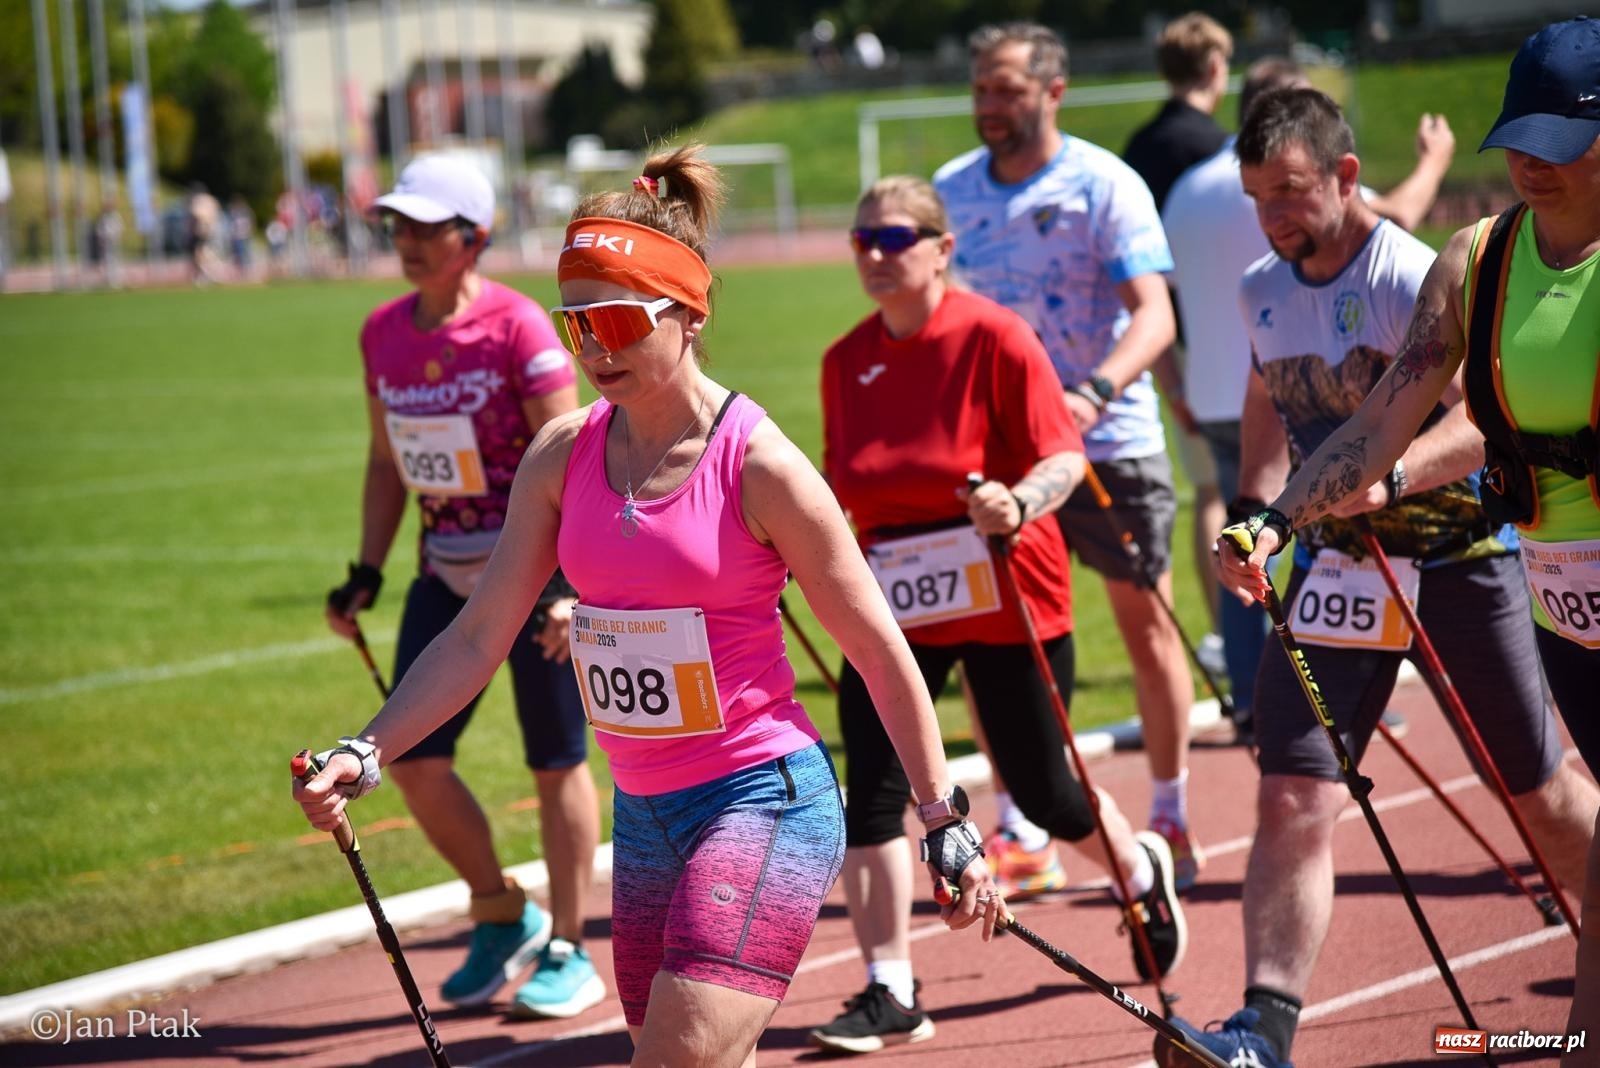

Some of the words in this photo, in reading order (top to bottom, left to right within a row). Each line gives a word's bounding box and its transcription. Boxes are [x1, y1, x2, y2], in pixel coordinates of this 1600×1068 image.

[403, 451, 454, 482] 093
[891, 570, 958, 611] 087
[1299, 590, 1375, 631] 095
[1542, 588, 1600, 631] 085
[575, 615, 590, 630] XVIII
[591, 618, 609, 631] BIEG
[610, 620, 626, 633] BEZ
[627, 620, 667, 633] GRANIC
[588, 664, 670, 715] 098
